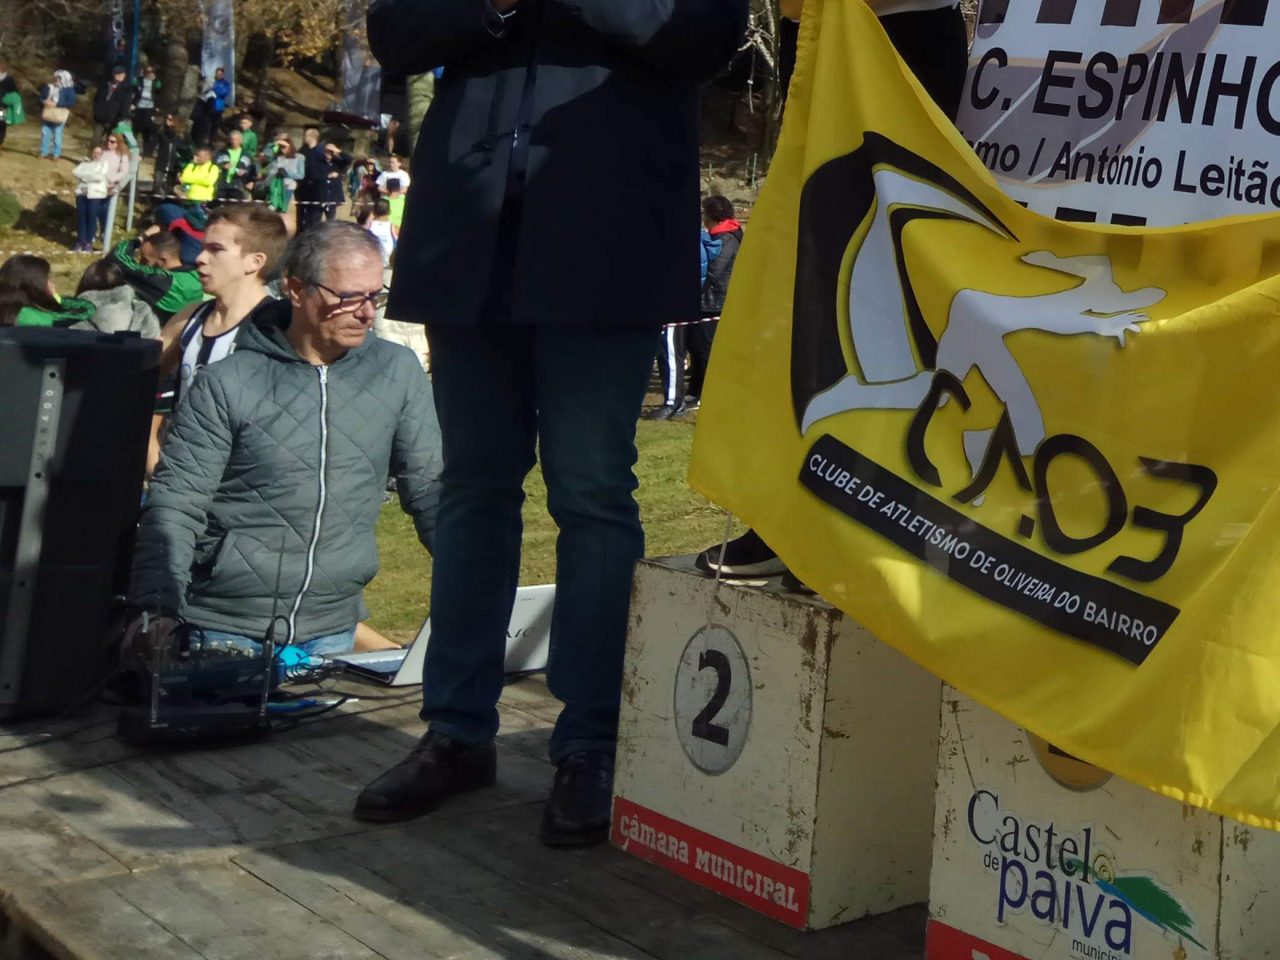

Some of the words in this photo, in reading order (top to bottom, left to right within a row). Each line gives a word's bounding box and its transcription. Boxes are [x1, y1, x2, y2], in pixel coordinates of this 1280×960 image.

[970, 47, 1012, 111] C.
[966, 140, 1020, 172] mo
[1048, 141, 1162, 188] António
[810, 454, 861, 495] CLUBE
[857, 486, 885, 508] DE
[880, 501, 969, 560] ATLETISMO
[969, 551, 996, 574] DE
[993, 564, 1056, 603] OLIVEIRA
[1054, 592, 1080, 614] DO
[1083, 602, 1157, 645] BAIRRO
[692, 649, 732, 747] 2
[968, 790, 1091, 885] Castel
[983, 851, 1000, 872] de
[997, 856, 1133, 956] paiva
